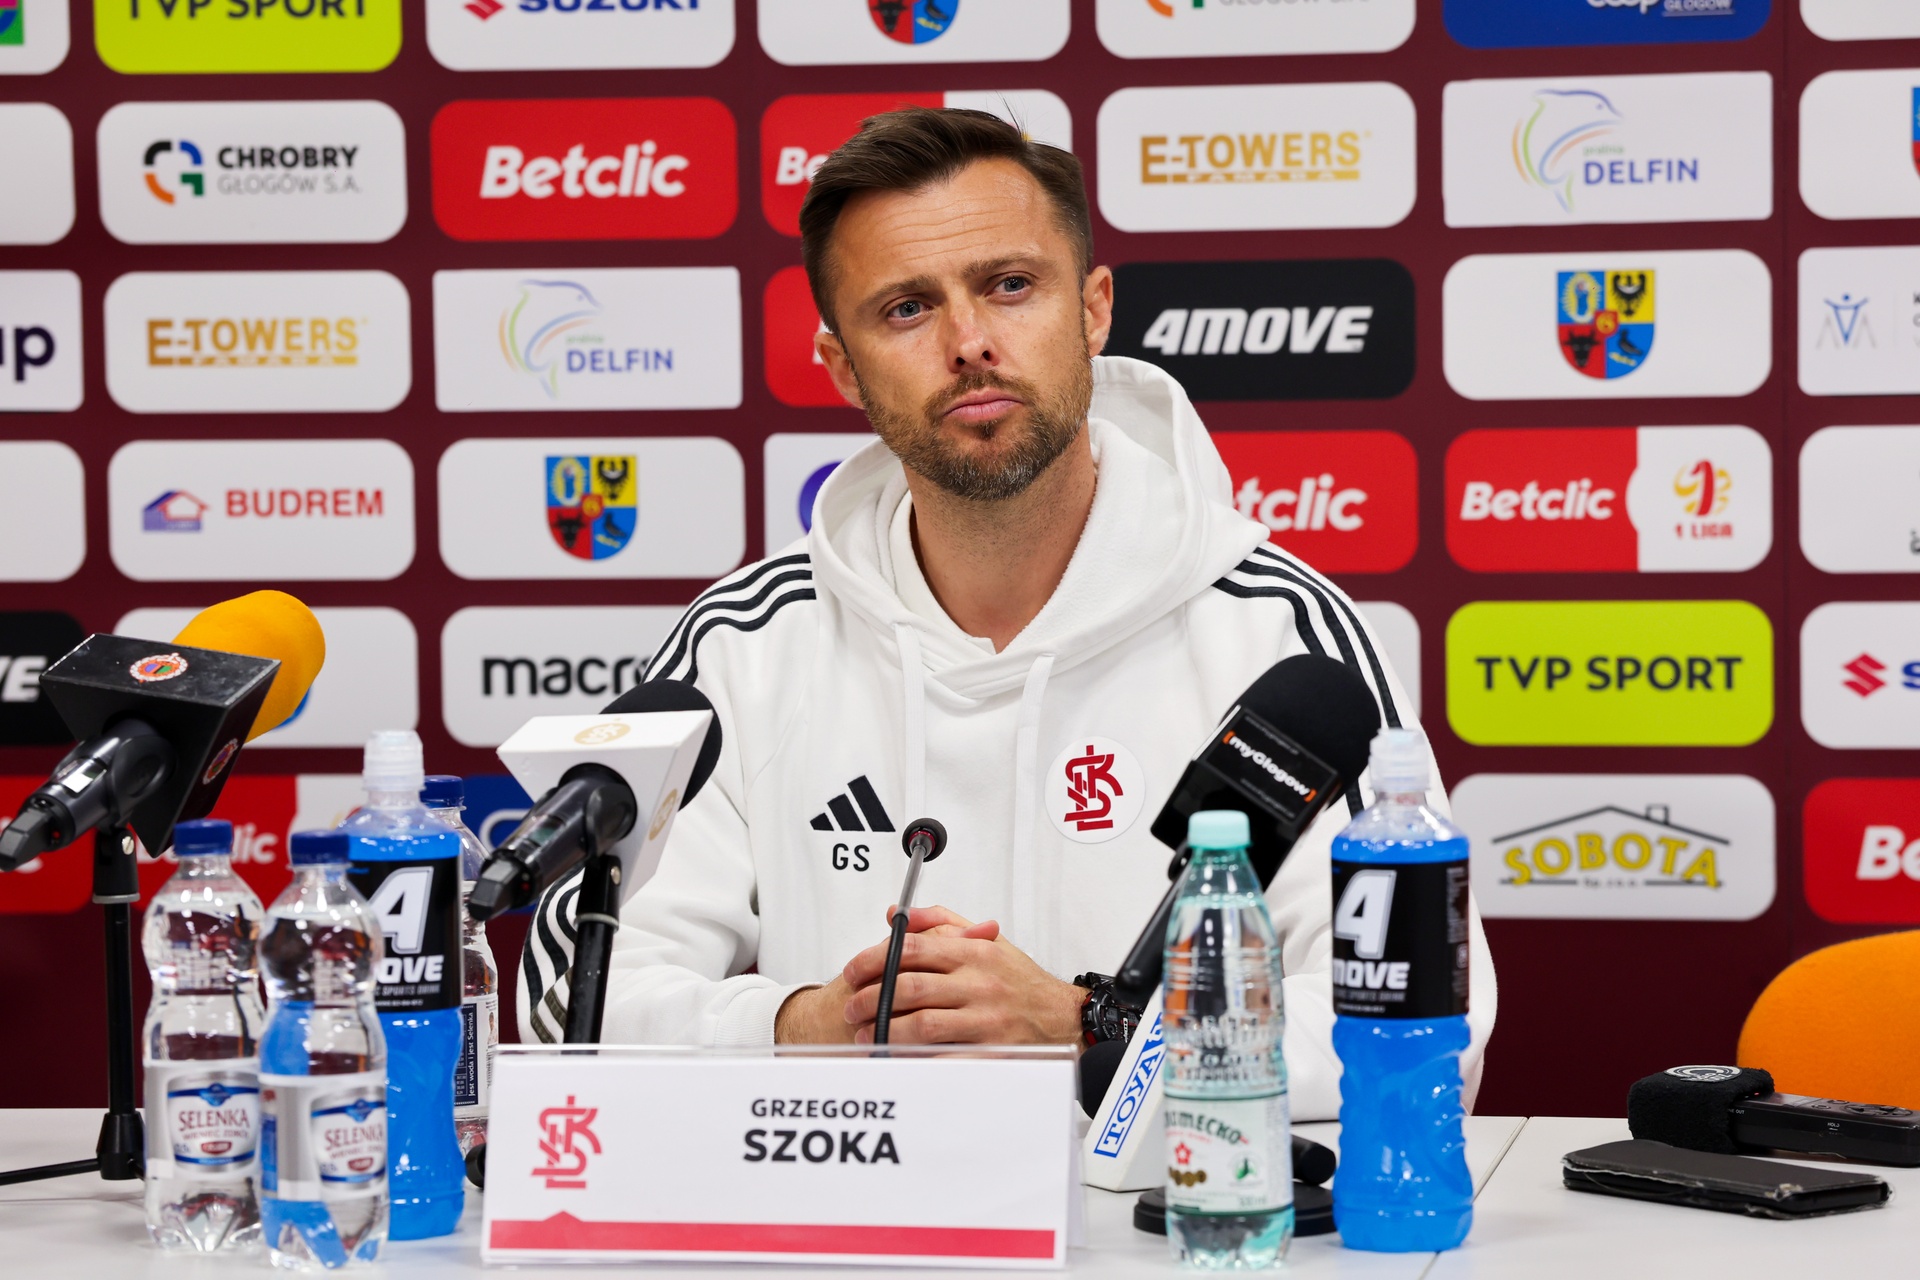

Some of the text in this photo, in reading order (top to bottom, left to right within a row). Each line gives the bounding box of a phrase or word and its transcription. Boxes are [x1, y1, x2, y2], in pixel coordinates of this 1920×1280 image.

[218, 147, 358, 169] CHROBRY
[479, 140, 689, 198] Betclic
[1141, 131, 1361, 183] E-TOWERS
[1584, 158, 1698, 185] DELFIN
[147, 318, 358, 366] E-TOWERS
[1142, 306, 1373, 355] 4MOVE
[567, 349, 673, 372] DELFIN
[225, 488, 384, 518] BUDREM
[1233, 473, 1368, 532] tclic
[1459, 478, 1616, 520] Betclic
[1475, 655, 1743, 691] TVP SPORT
[832, 843, 870, 872] GS
[1503, 831, 1720, 888] SOBOTA
[1334, 869, 1397, 960] 4
[372, 955, 444, 984] OVE
[750, 1098, 896, 1119] GRZEGORZ
[1103, 1051, 1160, 1146] TOYA
[178, 1108, 250, 1132] SELENKA
[743, 1129, 899, 1164] SZOKA
